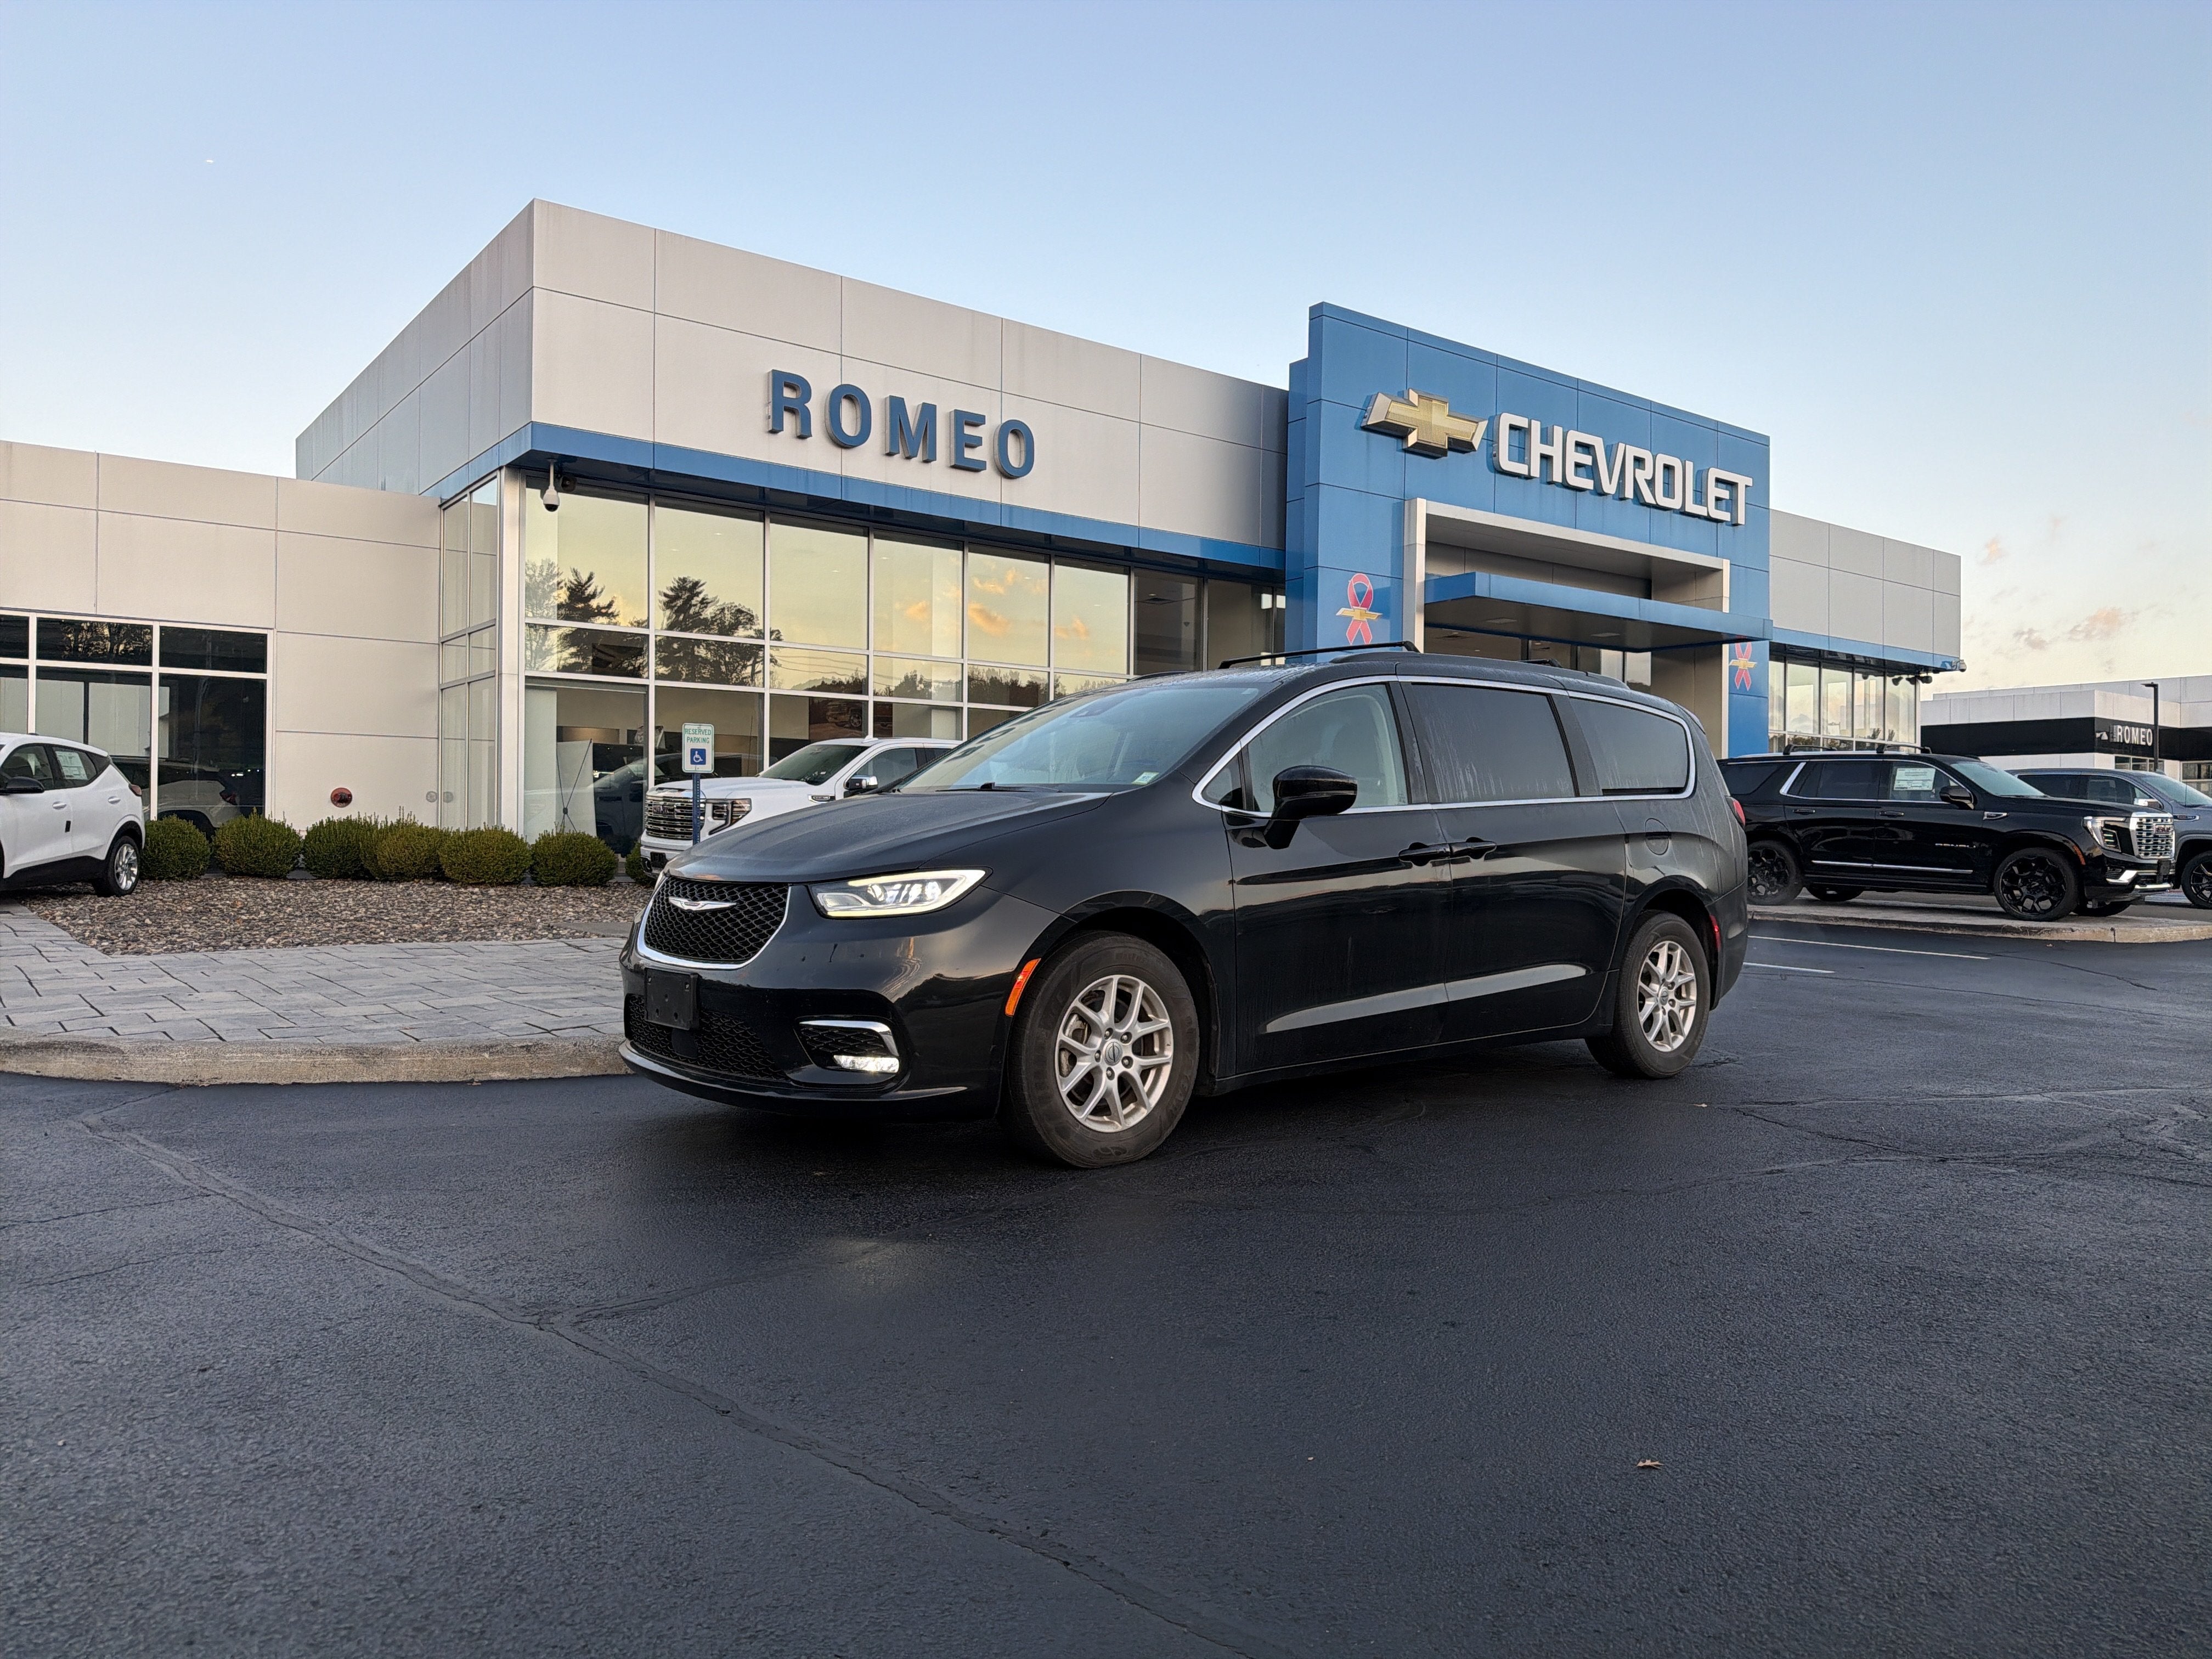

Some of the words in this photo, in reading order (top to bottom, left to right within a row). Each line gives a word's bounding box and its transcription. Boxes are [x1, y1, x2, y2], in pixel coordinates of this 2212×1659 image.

[769, 369, 1034, 478] ROMEO
[1493, 413, 1753, 526] CHEVROLET
[2113, 725, 2153, 746] ROMEO
